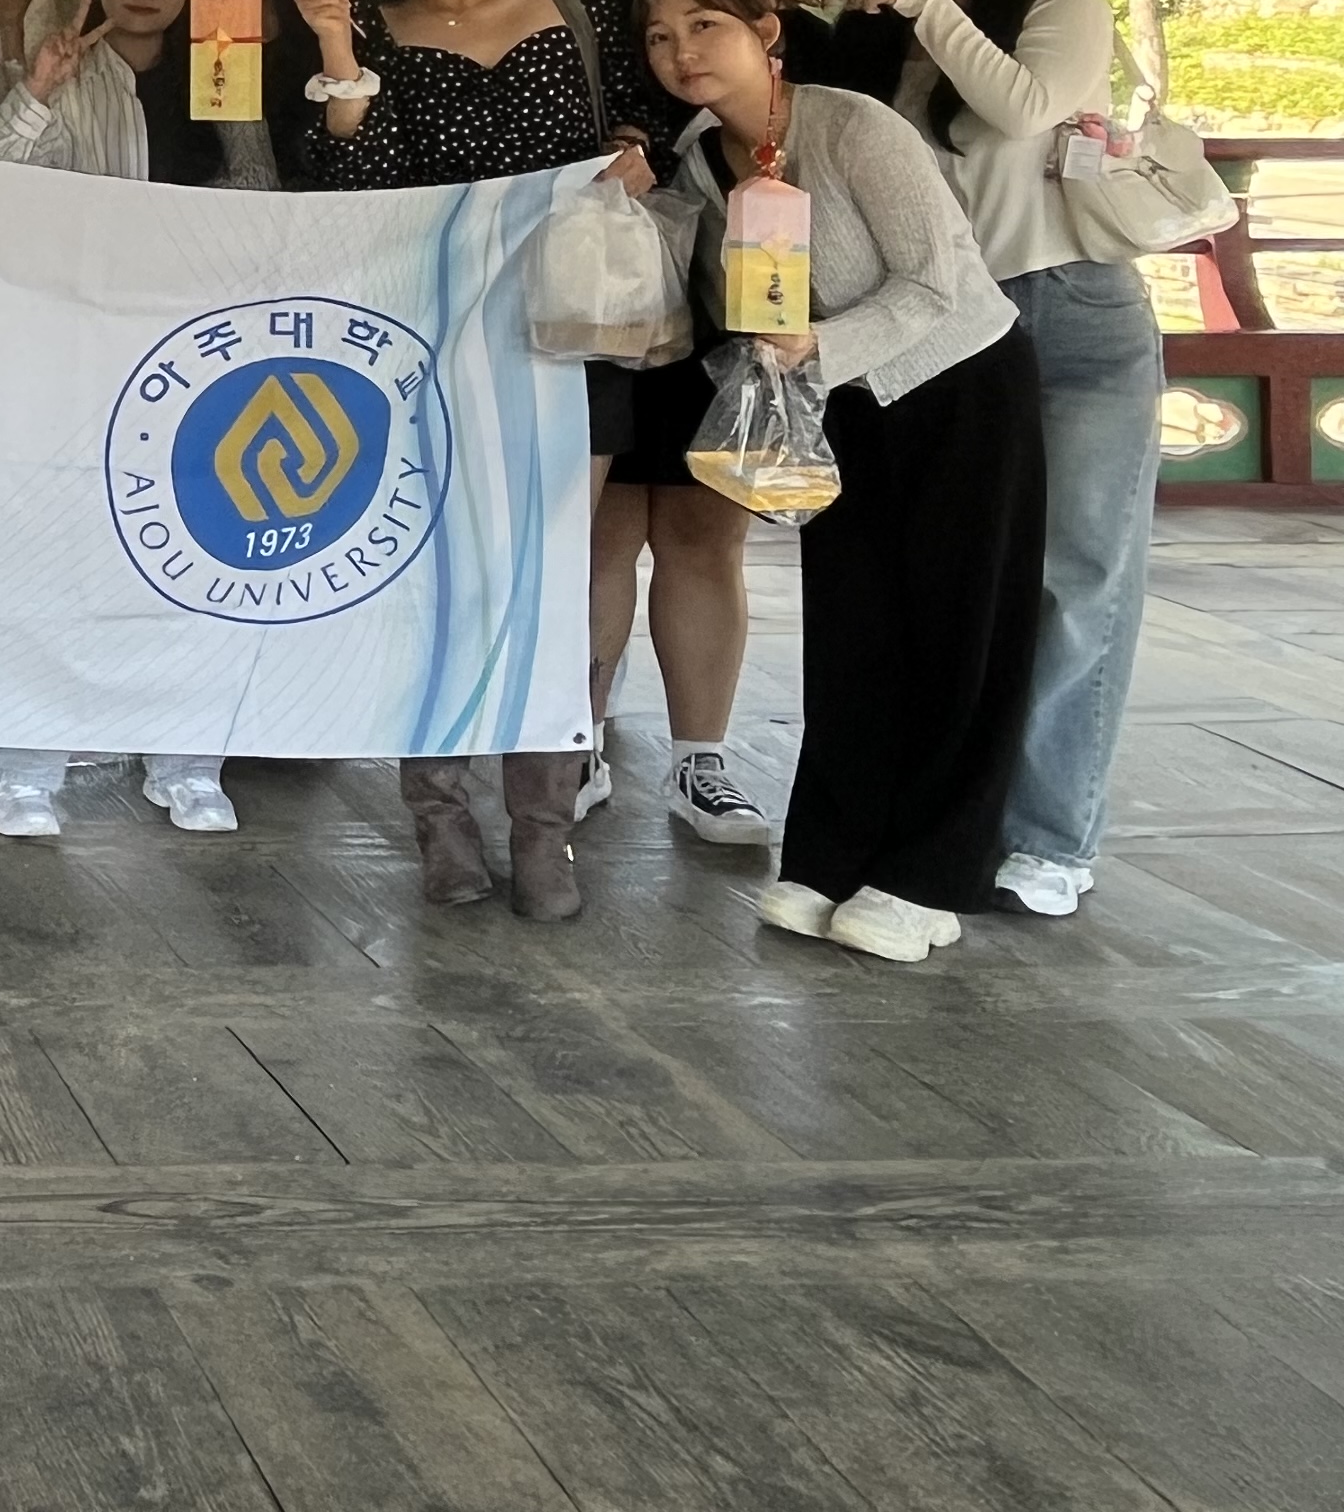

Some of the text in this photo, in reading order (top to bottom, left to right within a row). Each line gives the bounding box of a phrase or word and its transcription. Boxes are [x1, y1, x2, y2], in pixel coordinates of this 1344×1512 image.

[139, 311, 428, 402] 아주대학교
[119, 456, 430, 607] AJOU UNIVERSITY
[245, 522, 314, 559] 1973
